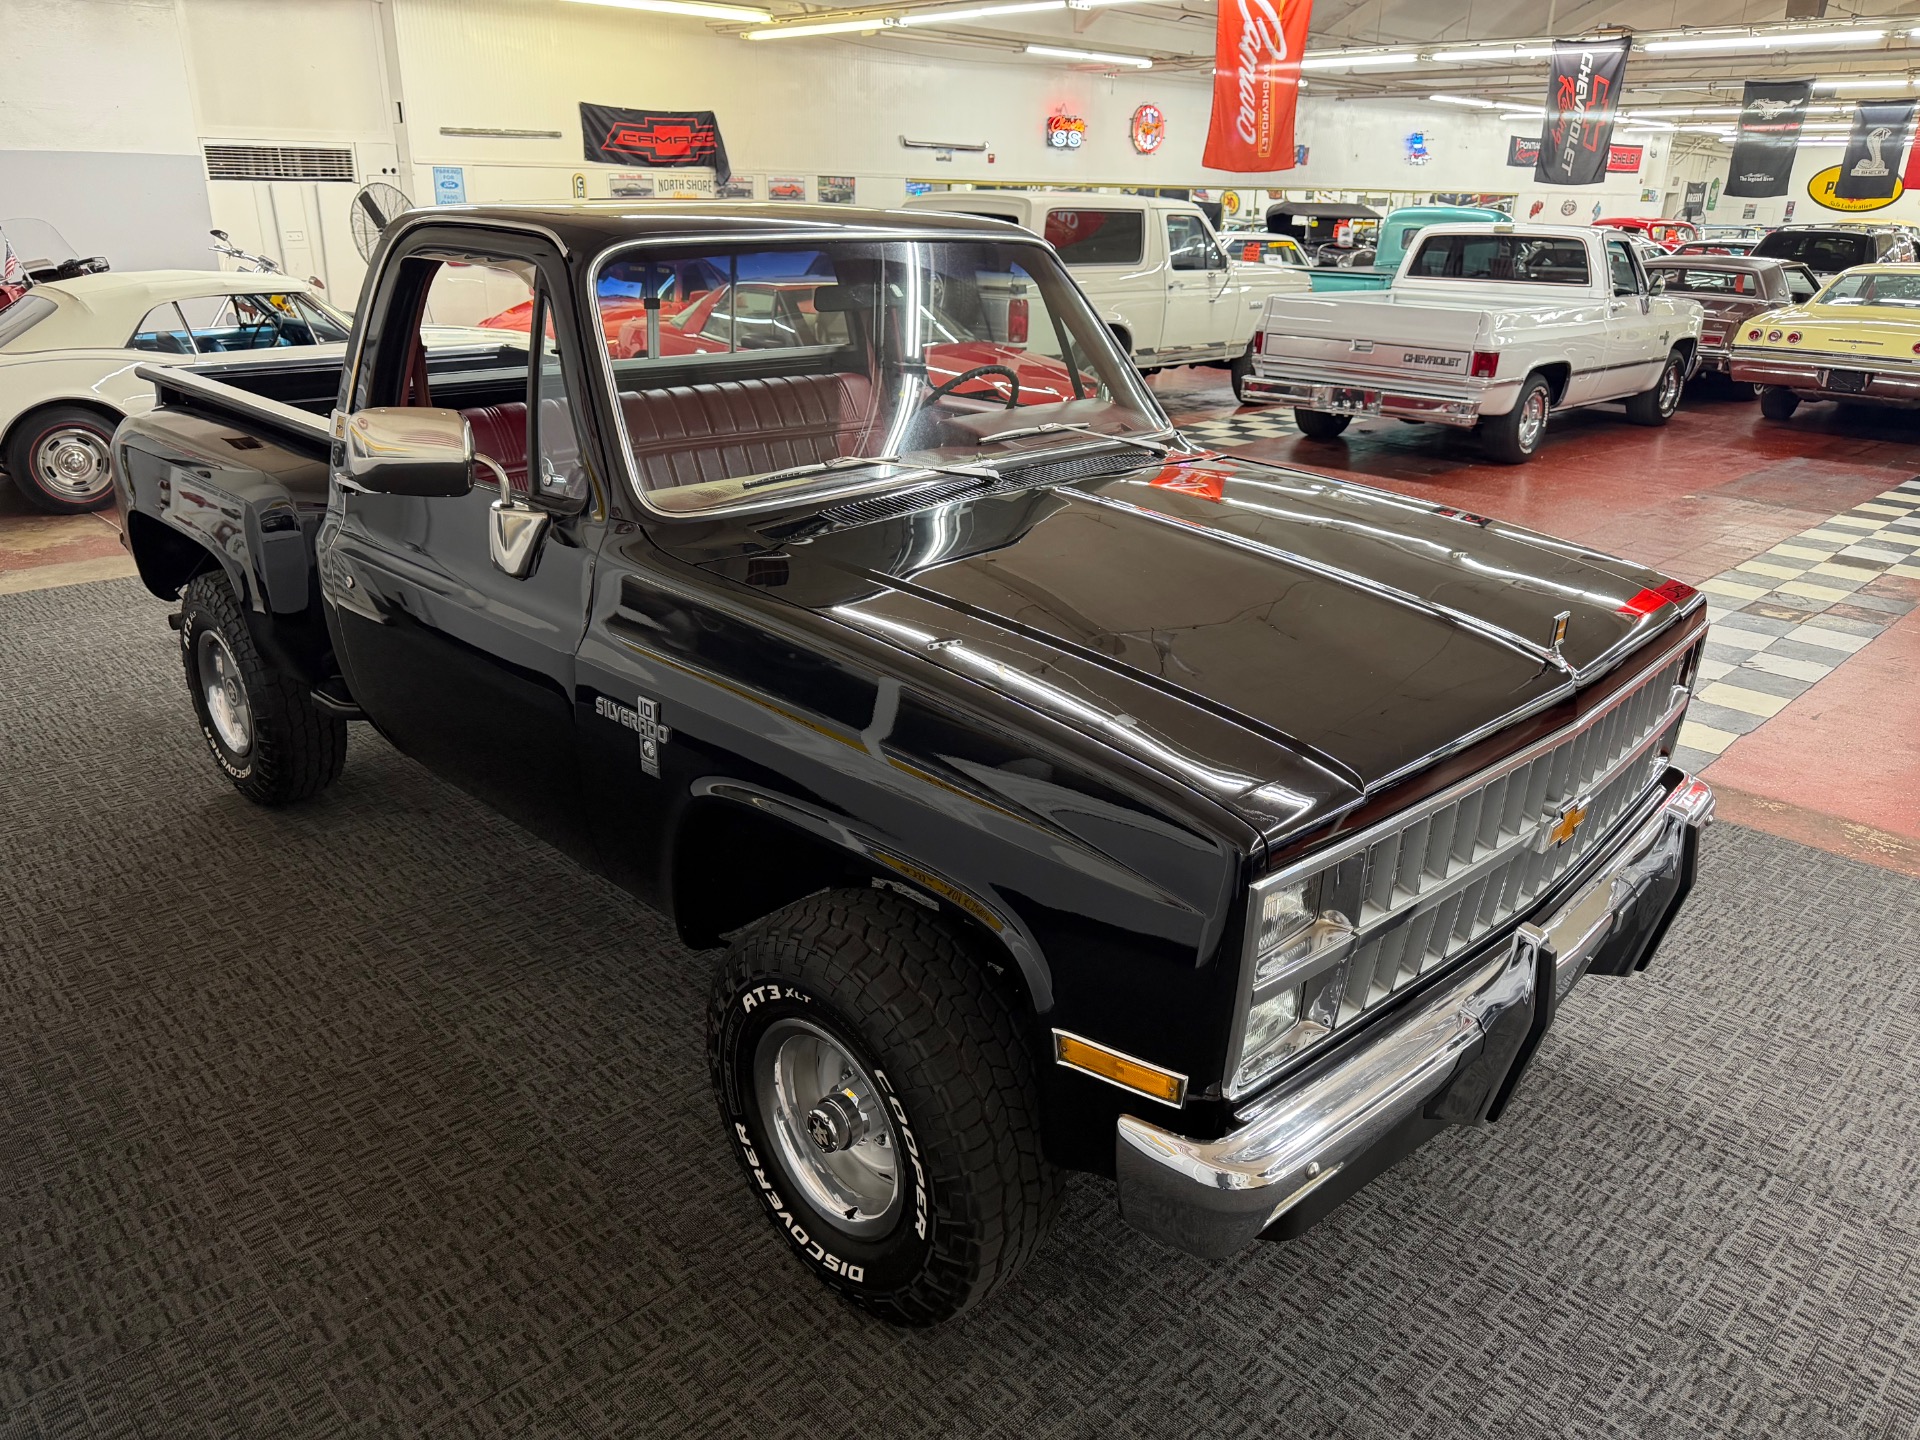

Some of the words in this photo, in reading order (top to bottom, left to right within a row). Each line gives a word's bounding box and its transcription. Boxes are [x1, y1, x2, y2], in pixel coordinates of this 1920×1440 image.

[1261, 81, 1271, 151] CHEVROLET
[1551, 74, 1576, 152] Racing
[1561, 51, 1594, 177] CHEVROLET
[622, 133, 715, 145] CAMARO
[1051, 130, 1082, 147] SS
[1611, 152, 1640, 165] SHELBY
[658, 179, 685, 193] NORTH
[686, 179, 713, 194] SHORE
[1403, 353, 1462, 367] CHEVROLET
[183, 617, 193, 650] AT3
[595, 696, 671, 745] SILVERADO
[742, 984, 782, 1014] AT3
[784, 987, 812, 1003] XLT
[873, 1069, 927, 1241] COOPER
[734, 1121, 865, 1283] DISCOVERER
